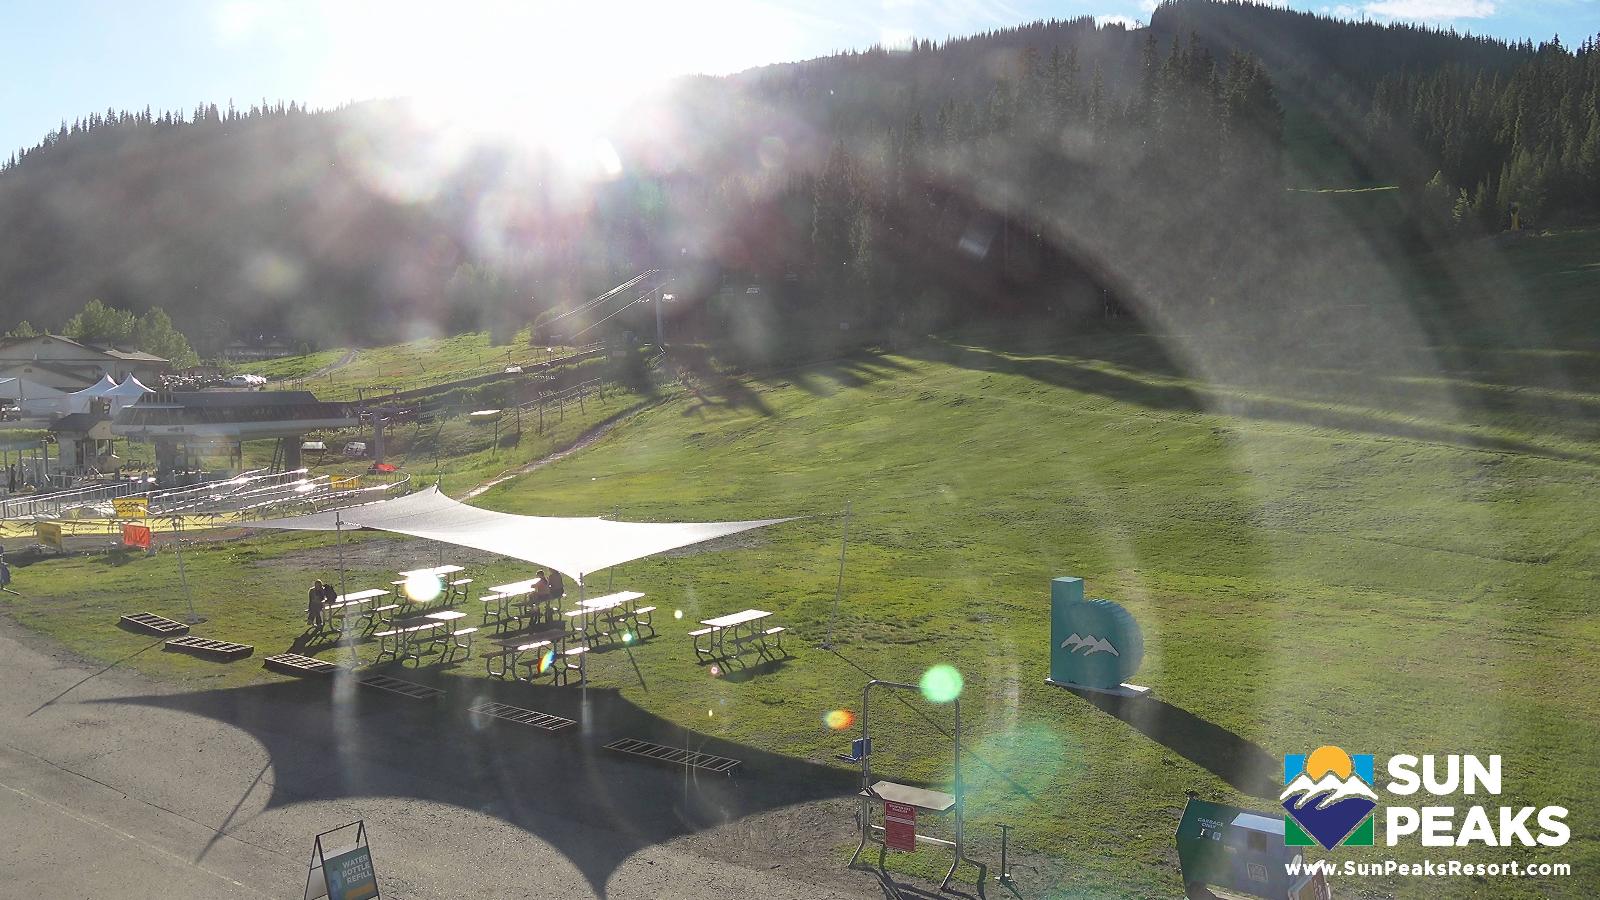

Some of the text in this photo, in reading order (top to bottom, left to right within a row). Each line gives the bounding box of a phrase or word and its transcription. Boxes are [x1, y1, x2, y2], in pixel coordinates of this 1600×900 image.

[342, 854, 369, 869] WATER
[342, 862, 371, 878] BOTTLE
[346, 870, 372, 885] REFILL
